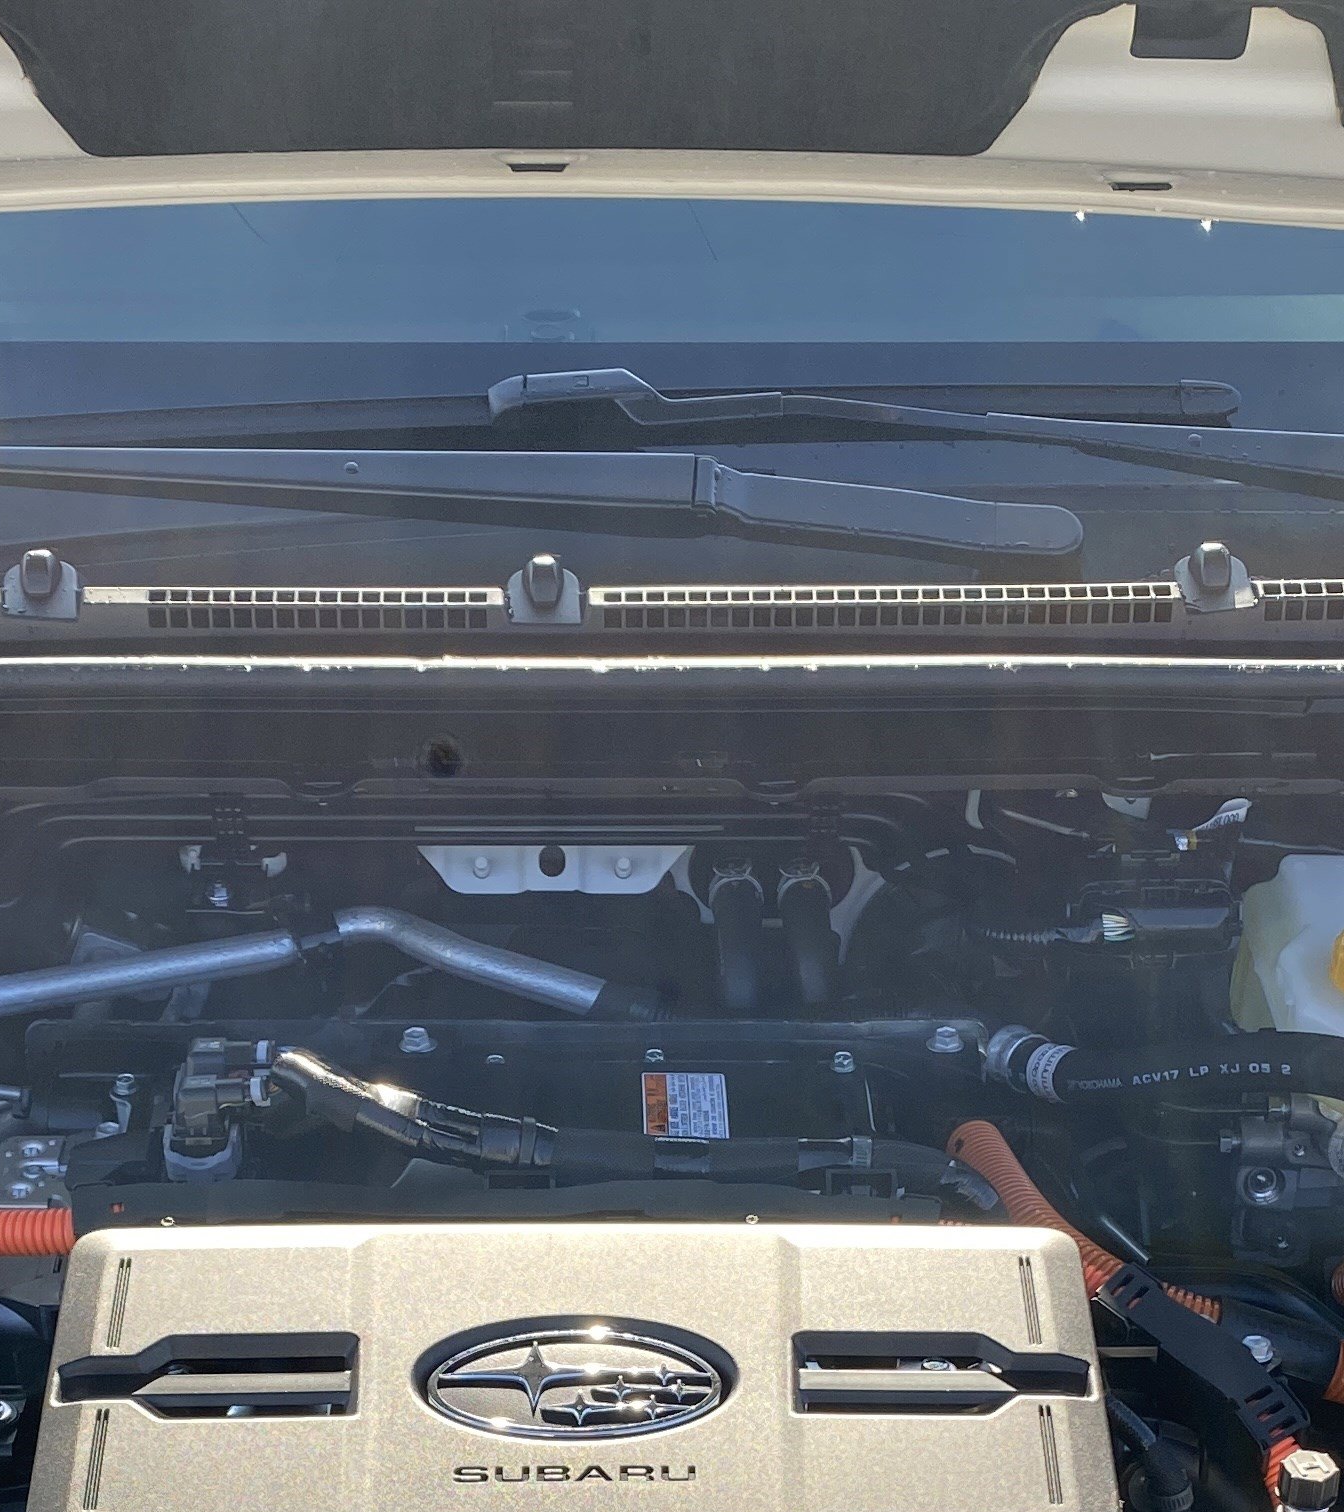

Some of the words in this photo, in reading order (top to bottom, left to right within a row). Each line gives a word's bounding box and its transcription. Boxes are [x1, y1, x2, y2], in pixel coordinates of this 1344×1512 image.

[1132, 1069, 1179, 1085] ACV17
[1189, 1065, 1209, 1078] LP
[1219, 1063, 1240, 1074] XJ
[1281, 1063, 1292, 1075] 2
[452, 1465, 697, 1483] SUBARU
